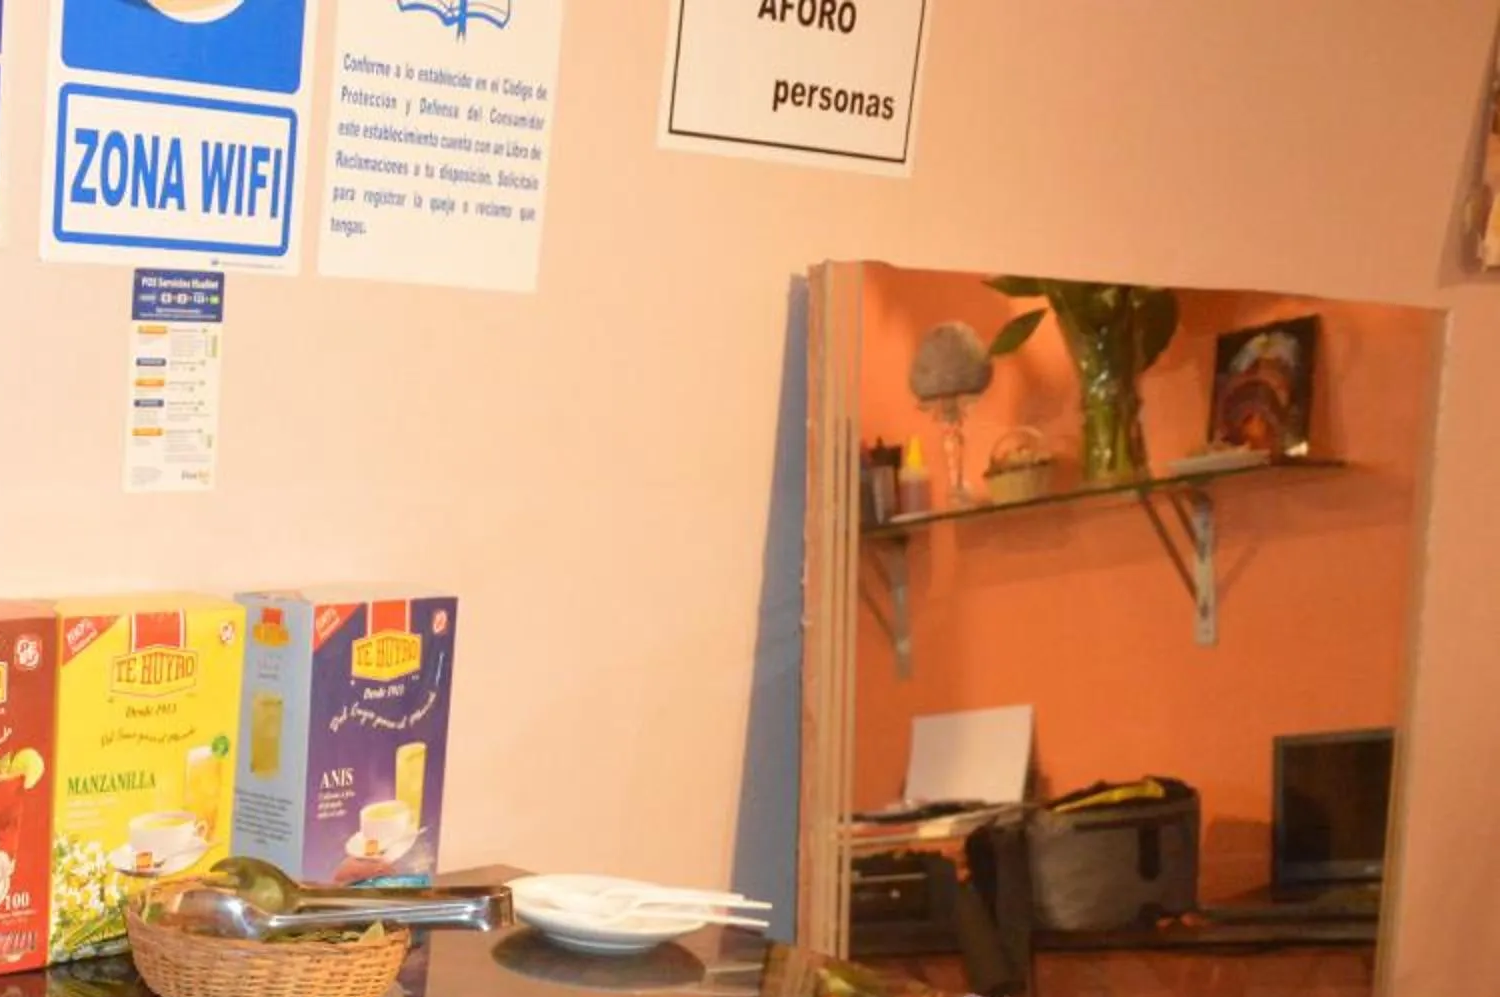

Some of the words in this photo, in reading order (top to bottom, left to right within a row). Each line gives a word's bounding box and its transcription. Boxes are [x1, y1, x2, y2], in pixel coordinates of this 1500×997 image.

[757, 0, 857, 34] AFORO
[343, 53, 390, 78] Conforme
[419, 96, 459, 119] Defensa
[772, 78, 896, 121] personas
[69, 128, 187, 211] ZONA
[201, 140, 284, 220] WIFI
[332, 185, 355, 204] para
[139, 650, 195, 686] HUYRO
[67, 770, 157, 796] MANZANILLA
[320, 767, 355, 789] ANIS
[4, 891, 31, 911] 100
